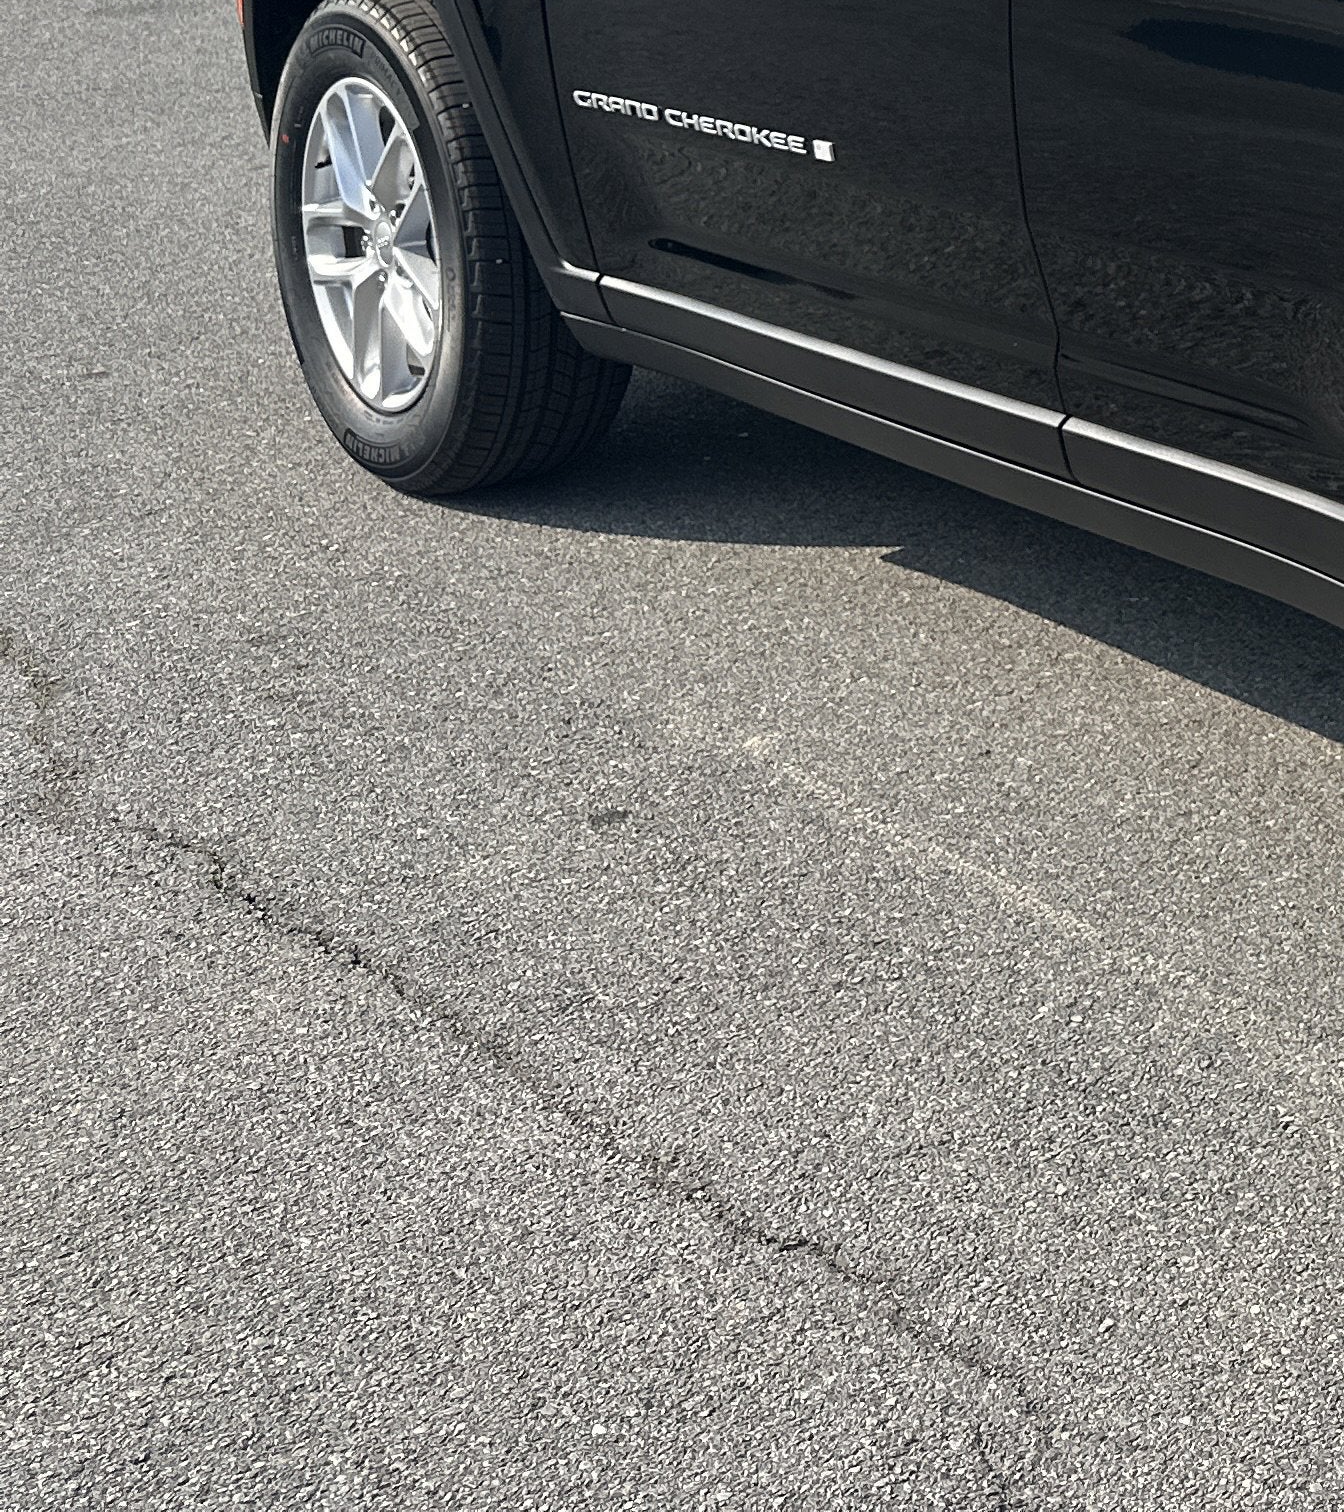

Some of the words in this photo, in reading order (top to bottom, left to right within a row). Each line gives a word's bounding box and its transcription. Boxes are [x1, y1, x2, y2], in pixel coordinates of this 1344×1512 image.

[310, 29, 364, 57] MICHELIN
[572, 89, 659, 121] GRAND
[664, 108, 808, 155] CHEROKEE
